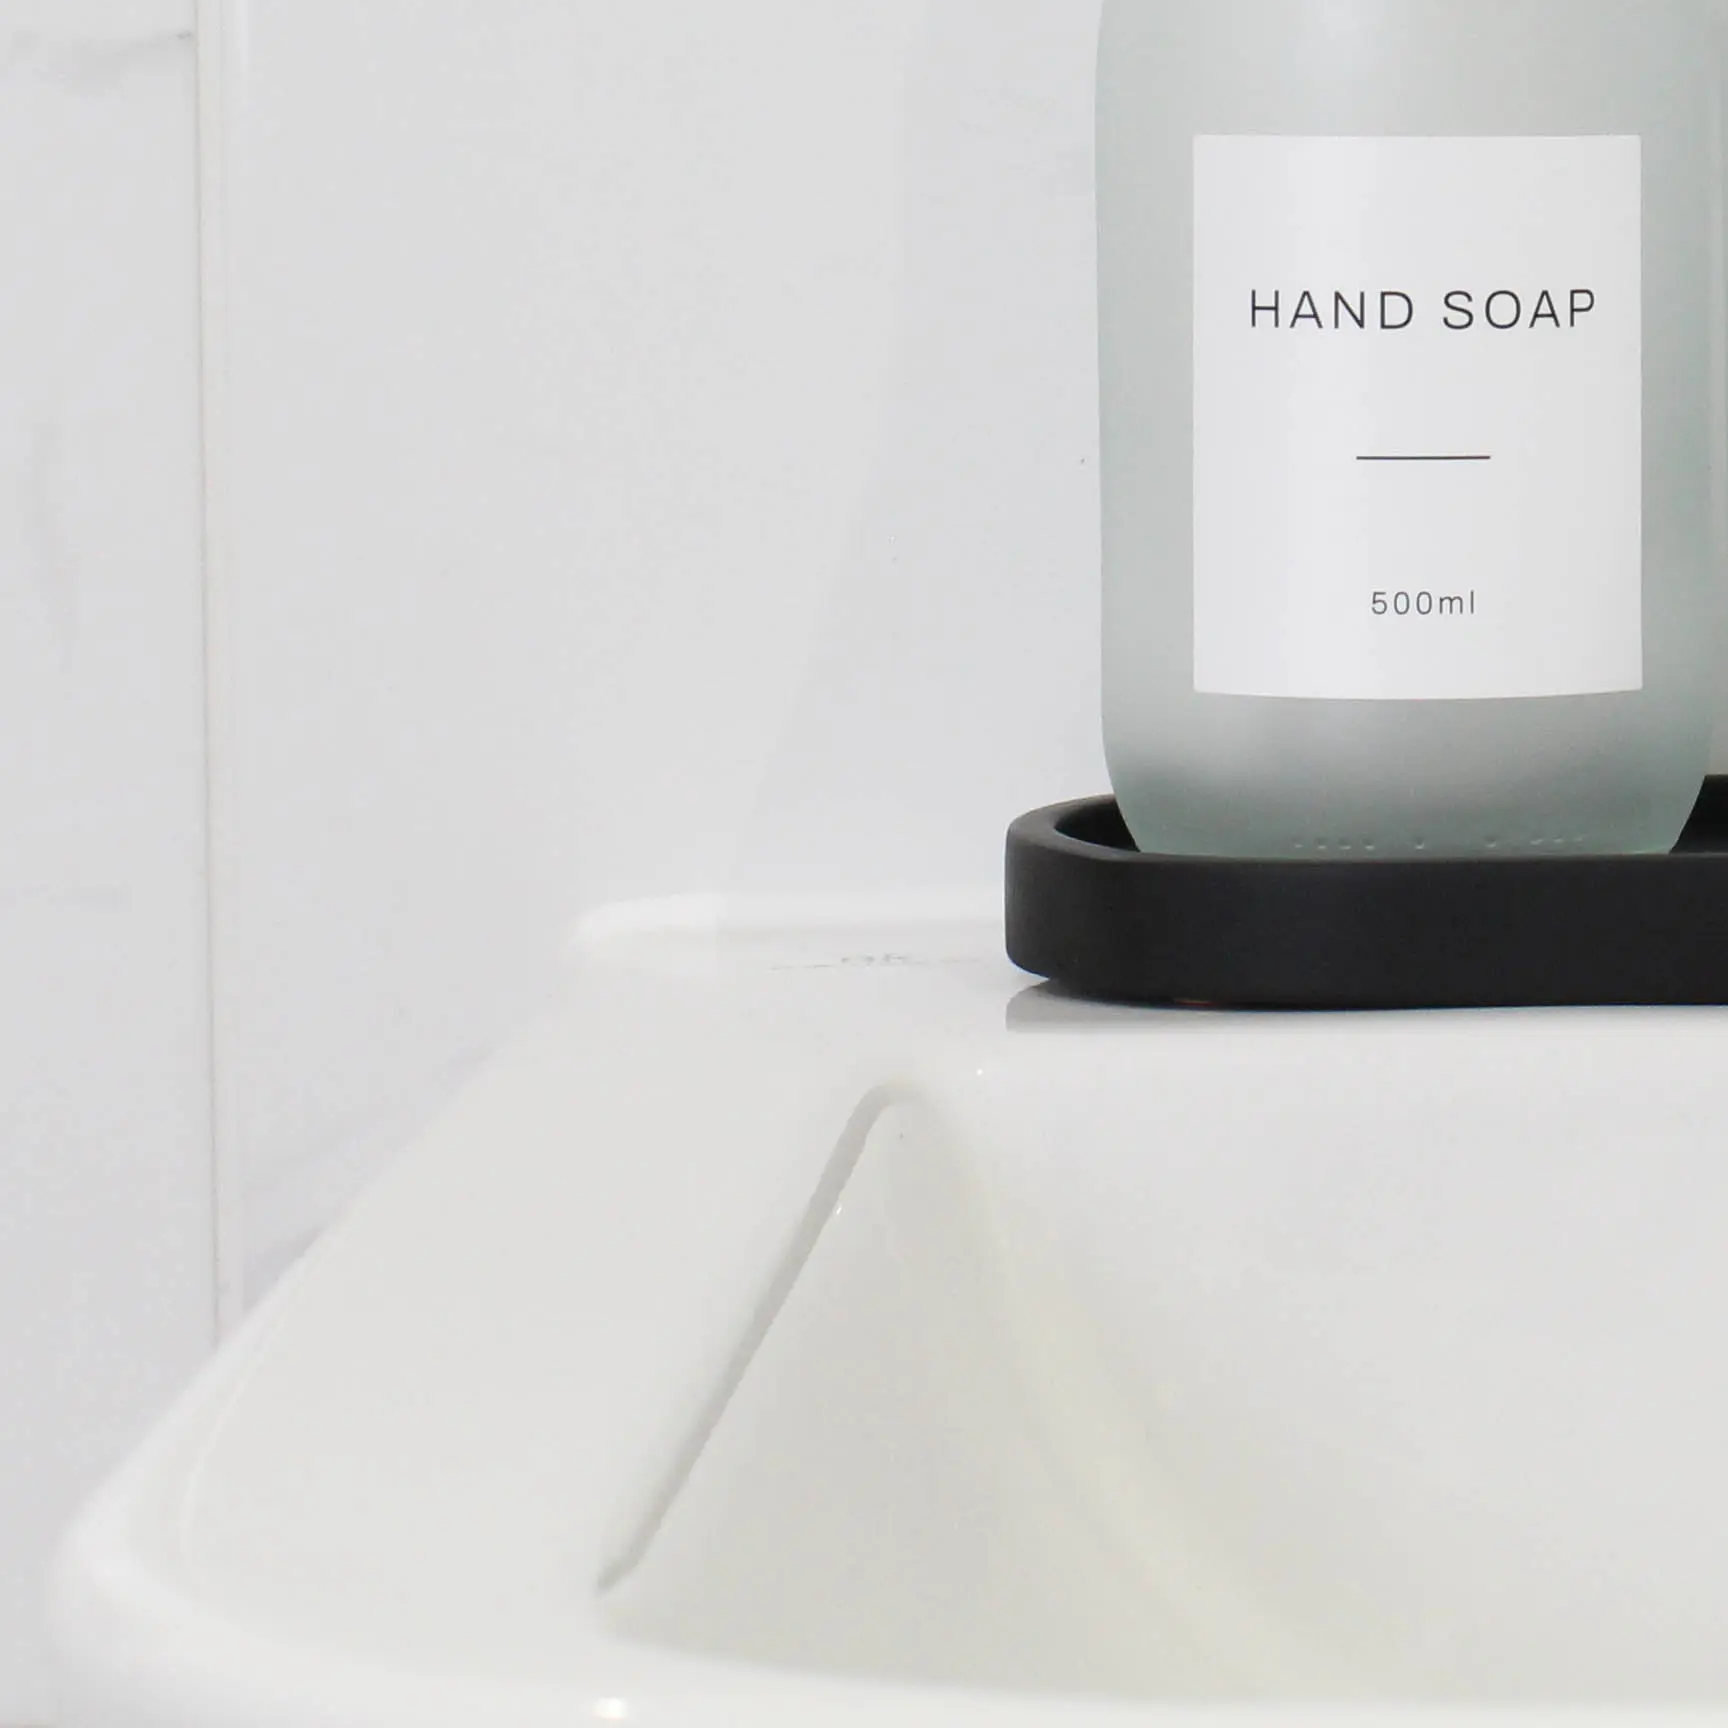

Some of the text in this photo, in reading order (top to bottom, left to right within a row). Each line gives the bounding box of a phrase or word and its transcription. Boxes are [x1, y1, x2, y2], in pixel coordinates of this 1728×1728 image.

[1250, 286, 1597, 331] HAND SOAP
[1370, 589, 1476, 617] 500ml
